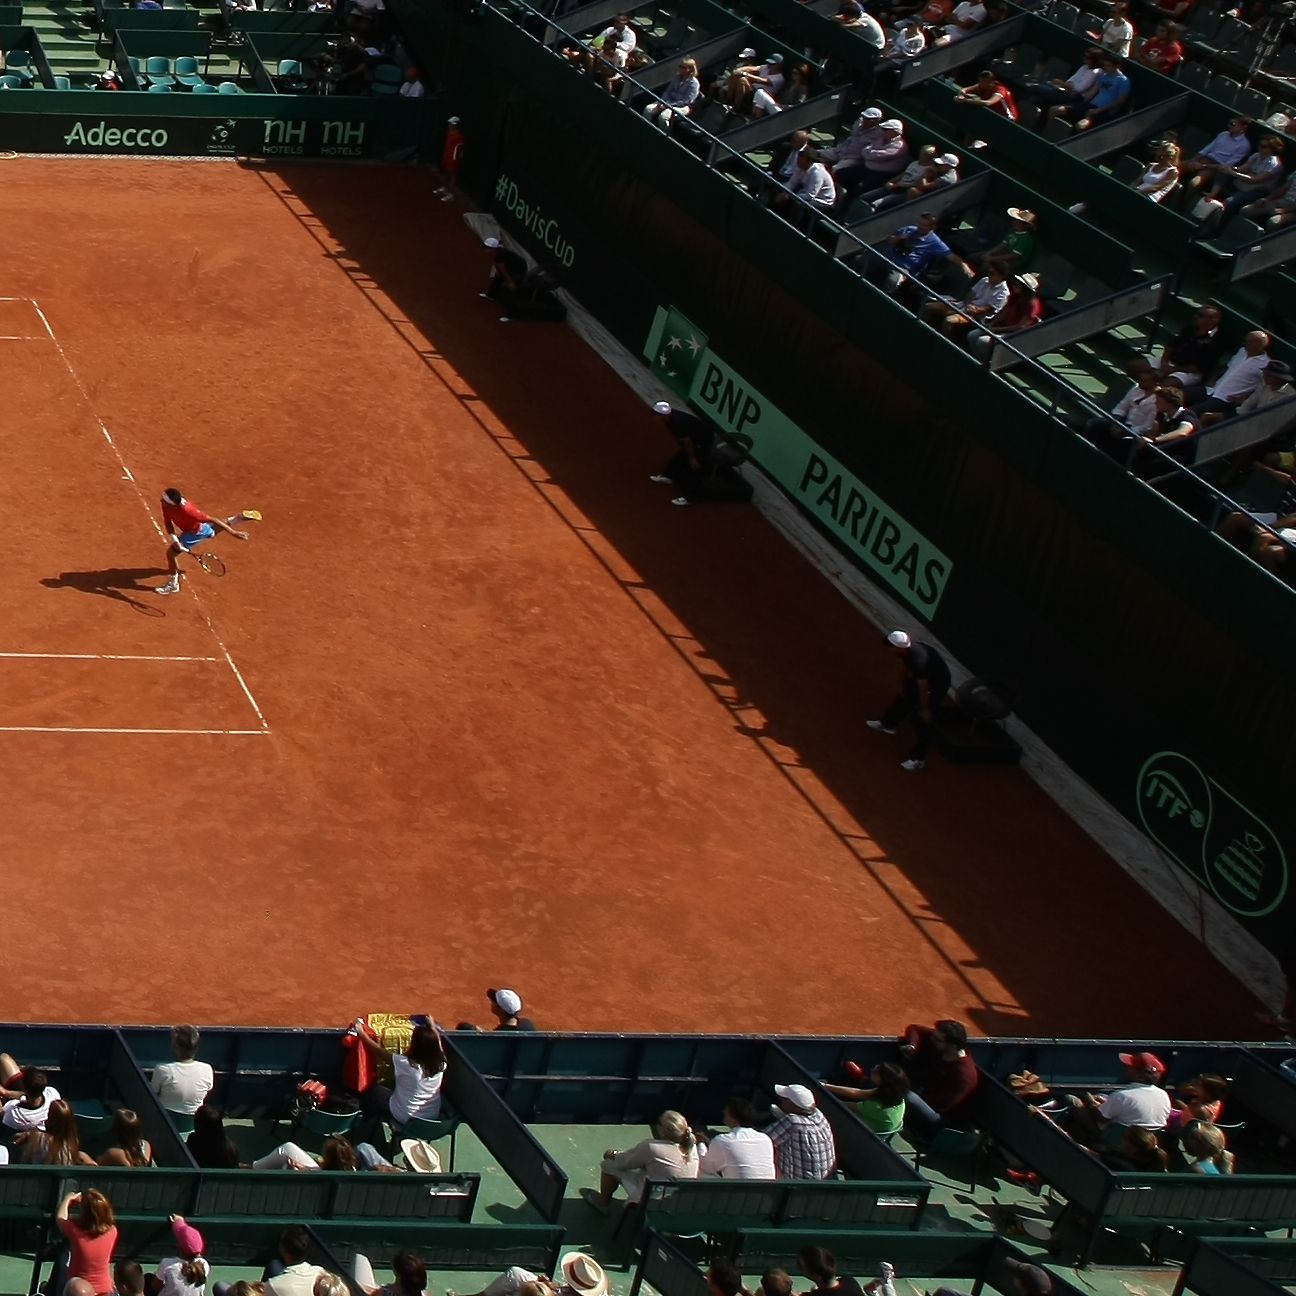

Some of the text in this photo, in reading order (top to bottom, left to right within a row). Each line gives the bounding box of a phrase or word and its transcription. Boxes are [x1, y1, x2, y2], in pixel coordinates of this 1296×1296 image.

[64, 121, 168, 148] Adecco
[263, 146, 362, 155] HOTELS HOTELS
[496, 174, 575, 267] #DavisCup
[699, 362, 945, 605] BNP PARIBAS
[1146, 777, 1188, 818] ITF
